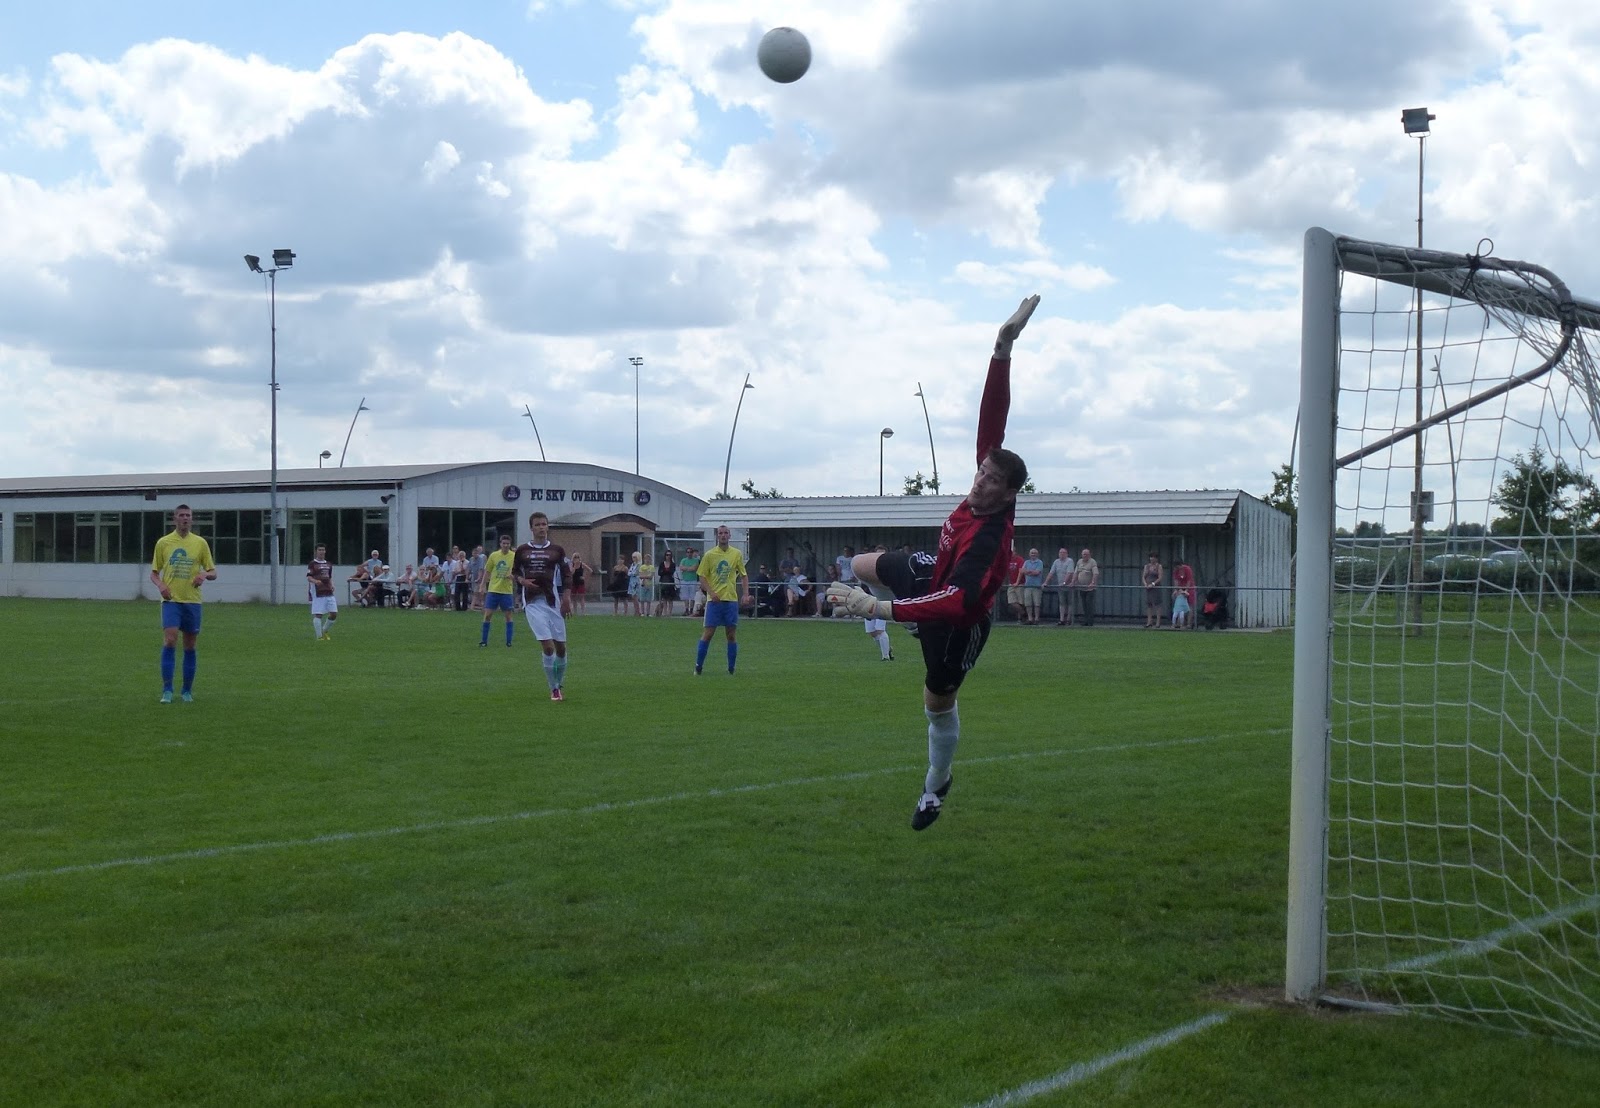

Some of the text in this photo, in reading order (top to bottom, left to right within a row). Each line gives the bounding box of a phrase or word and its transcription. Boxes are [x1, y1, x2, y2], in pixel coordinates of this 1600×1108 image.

[530, 488, 543, 501] FC
[546, 489, 566, 502] SKV
[571, 490, 624, 503] OVERMERE
